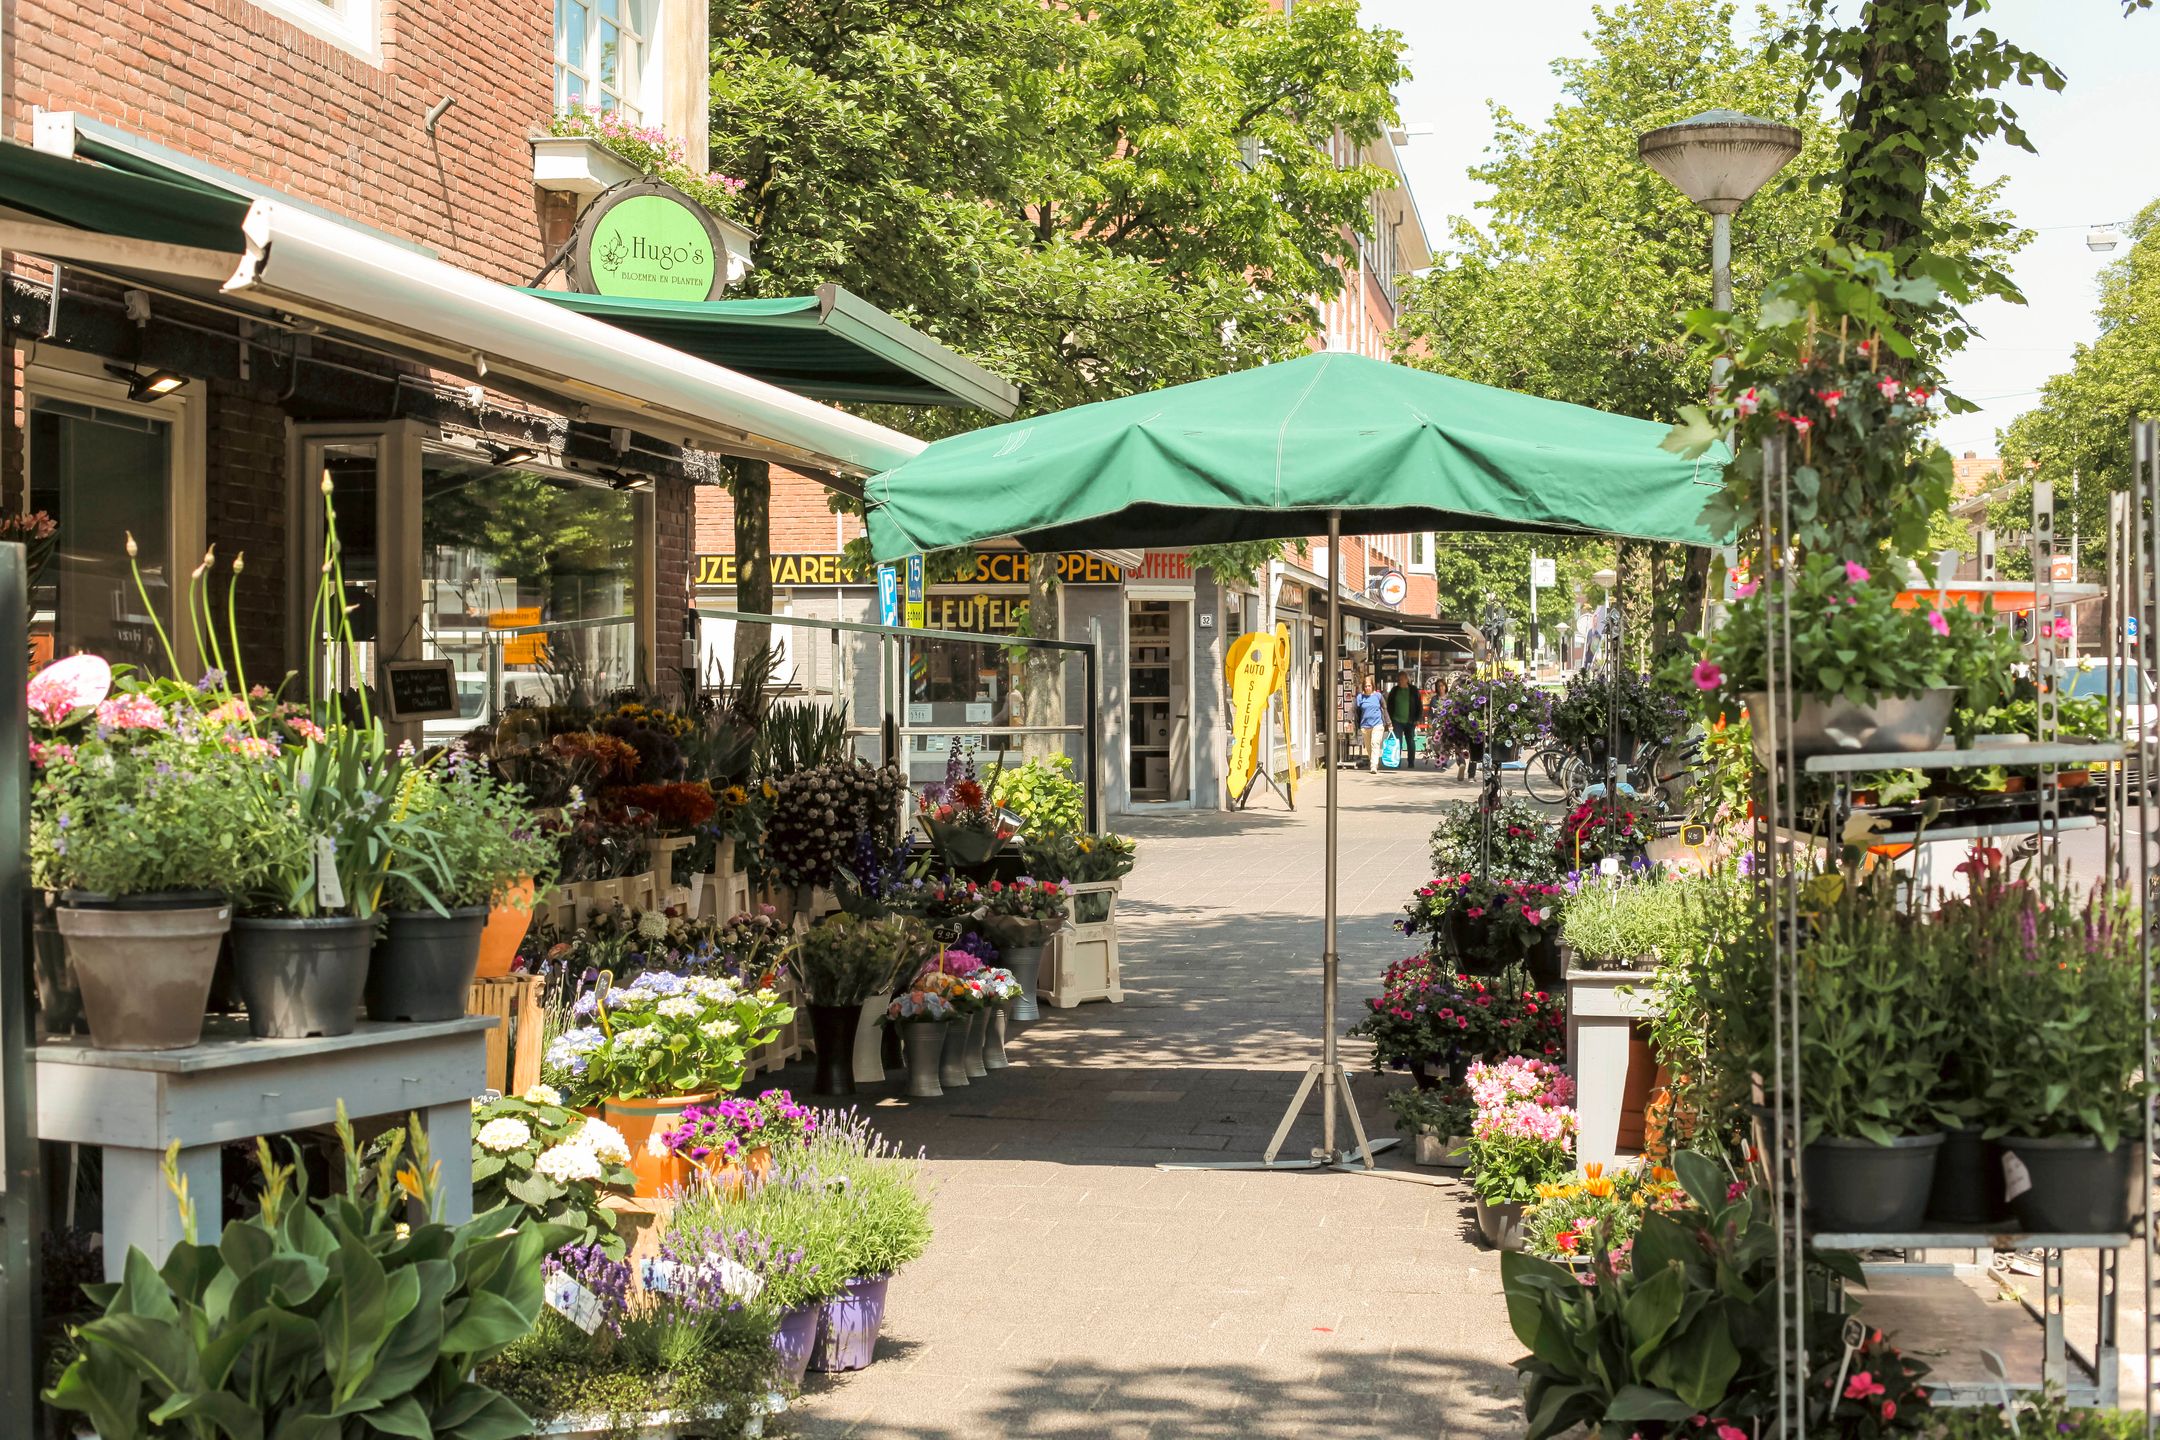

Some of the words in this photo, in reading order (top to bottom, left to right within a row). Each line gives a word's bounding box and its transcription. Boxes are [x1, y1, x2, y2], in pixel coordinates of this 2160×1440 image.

[633, 236, 704, 270] Hugo's
[622, 272, 656, 283] BLOEMEN
[660, 274, 669, 284] EN
[672, 276, 703, 287] PLANTEN
[910, 558, 921, 582] 15
[884, 574, 894, 605] P
[1202, 616, 1210, 625] 32
[1244, 664, 1265, 676] AUTO
[1237, 681, 1255, 770] SLEUTELS
